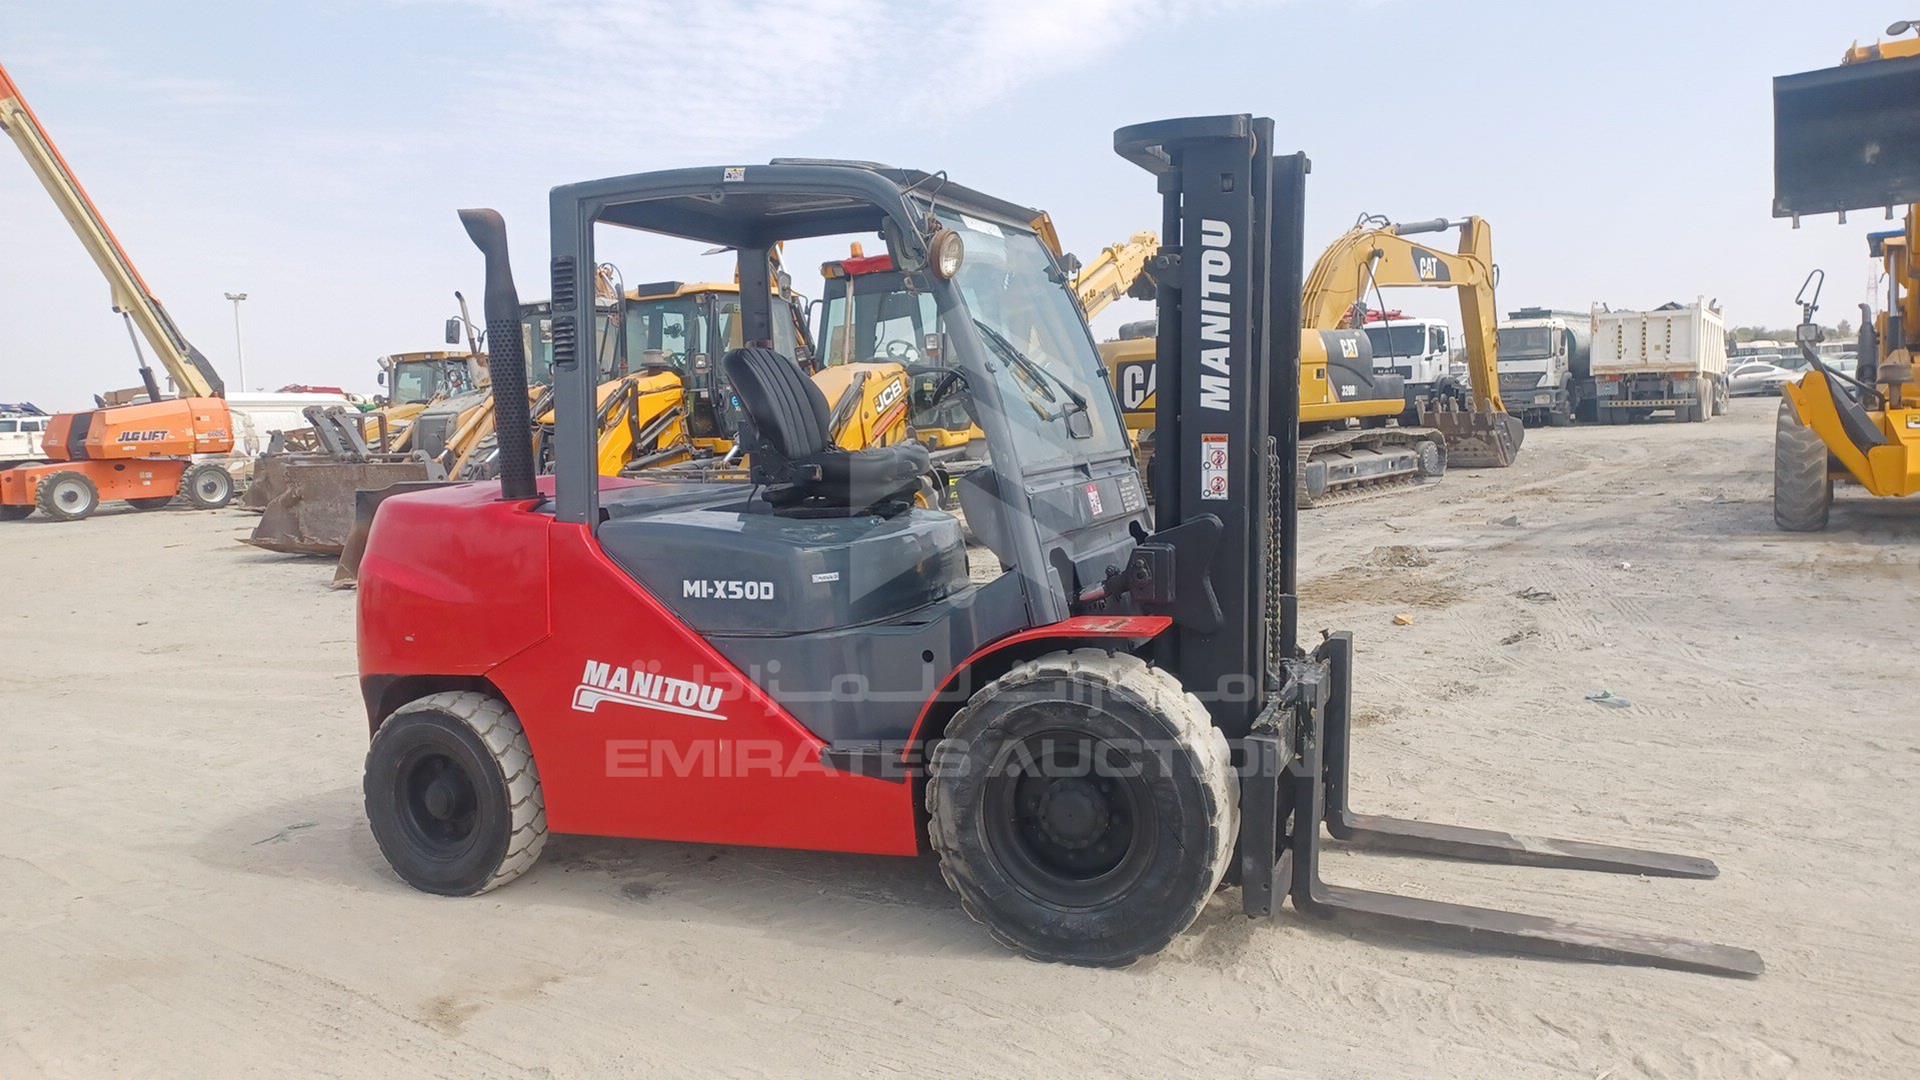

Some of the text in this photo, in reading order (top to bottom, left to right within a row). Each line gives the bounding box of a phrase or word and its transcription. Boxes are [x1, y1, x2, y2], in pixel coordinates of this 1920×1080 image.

[1420, 257, 1438, 279] CAT
[1200, 219, 1231, 411] MANITOU
[1340, 338, 1359, 358] CAT
[875, 379, 902, 412] JCB
[117, 430, 168, 442] JLG LIFT
[683, 579, 774, 600] MI-X50D
[581, 659, 724, 712] MANITOU
